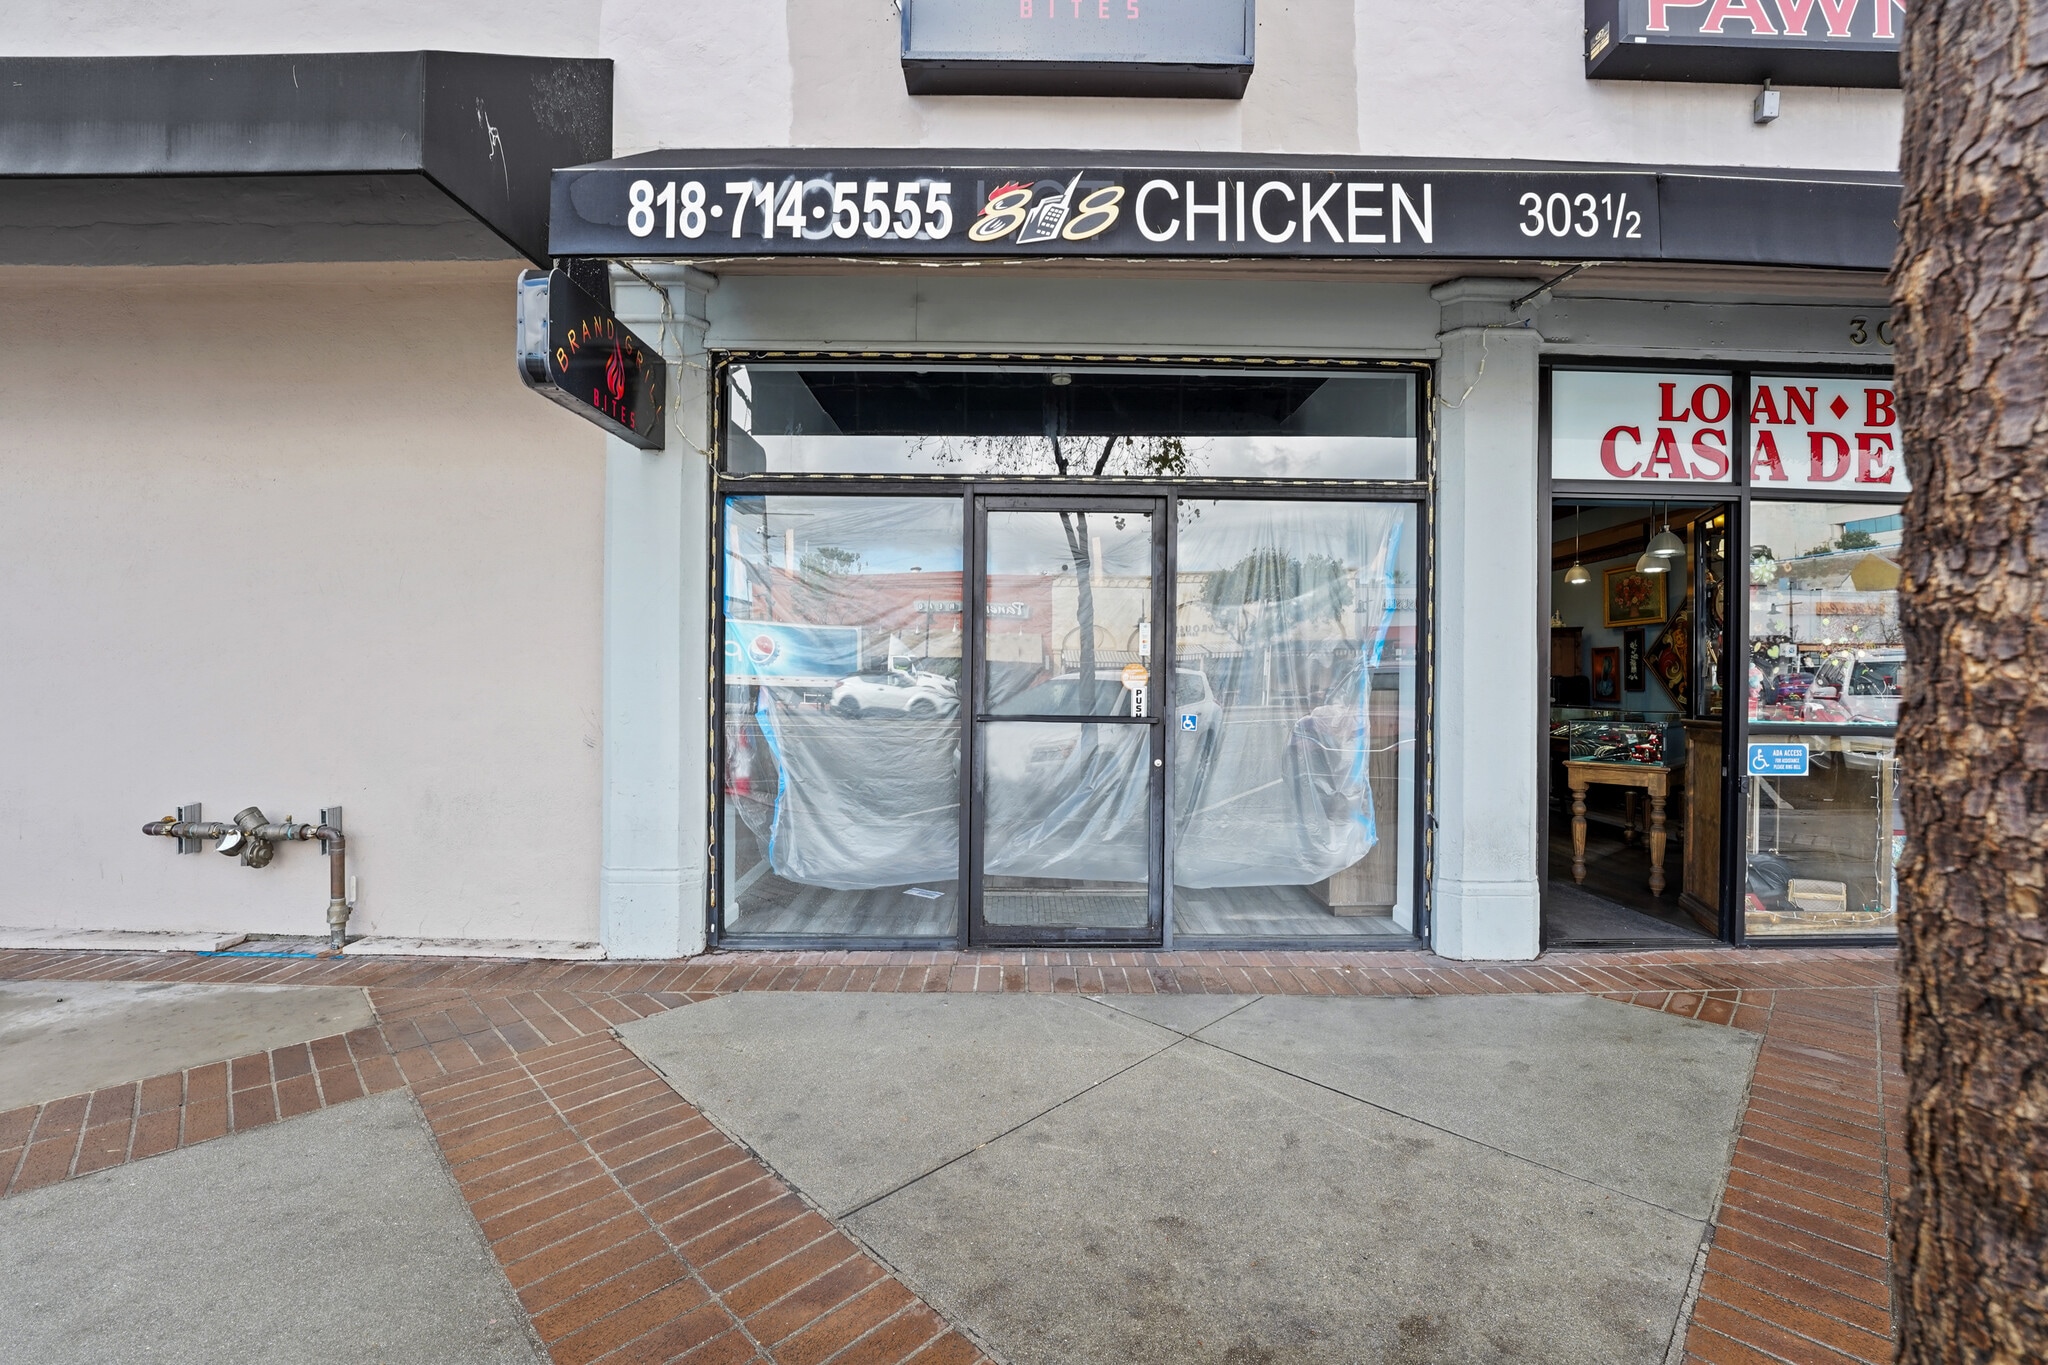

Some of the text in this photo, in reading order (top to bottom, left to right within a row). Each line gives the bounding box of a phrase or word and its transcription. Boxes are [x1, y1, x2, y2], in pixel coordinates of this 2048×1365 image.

[1020, 0, 1139, 19] BITES
[1135, 179, 1434, 245] CHICKEN
[556, 316, 615, 373] BRAND
[593, 387, 636, 429] BITES
[1658, 383, 1819, 425] LOAN
[1600, 425, 1895, 484] CASA DE
[1784, 749, 1803, 757] ACCESS
